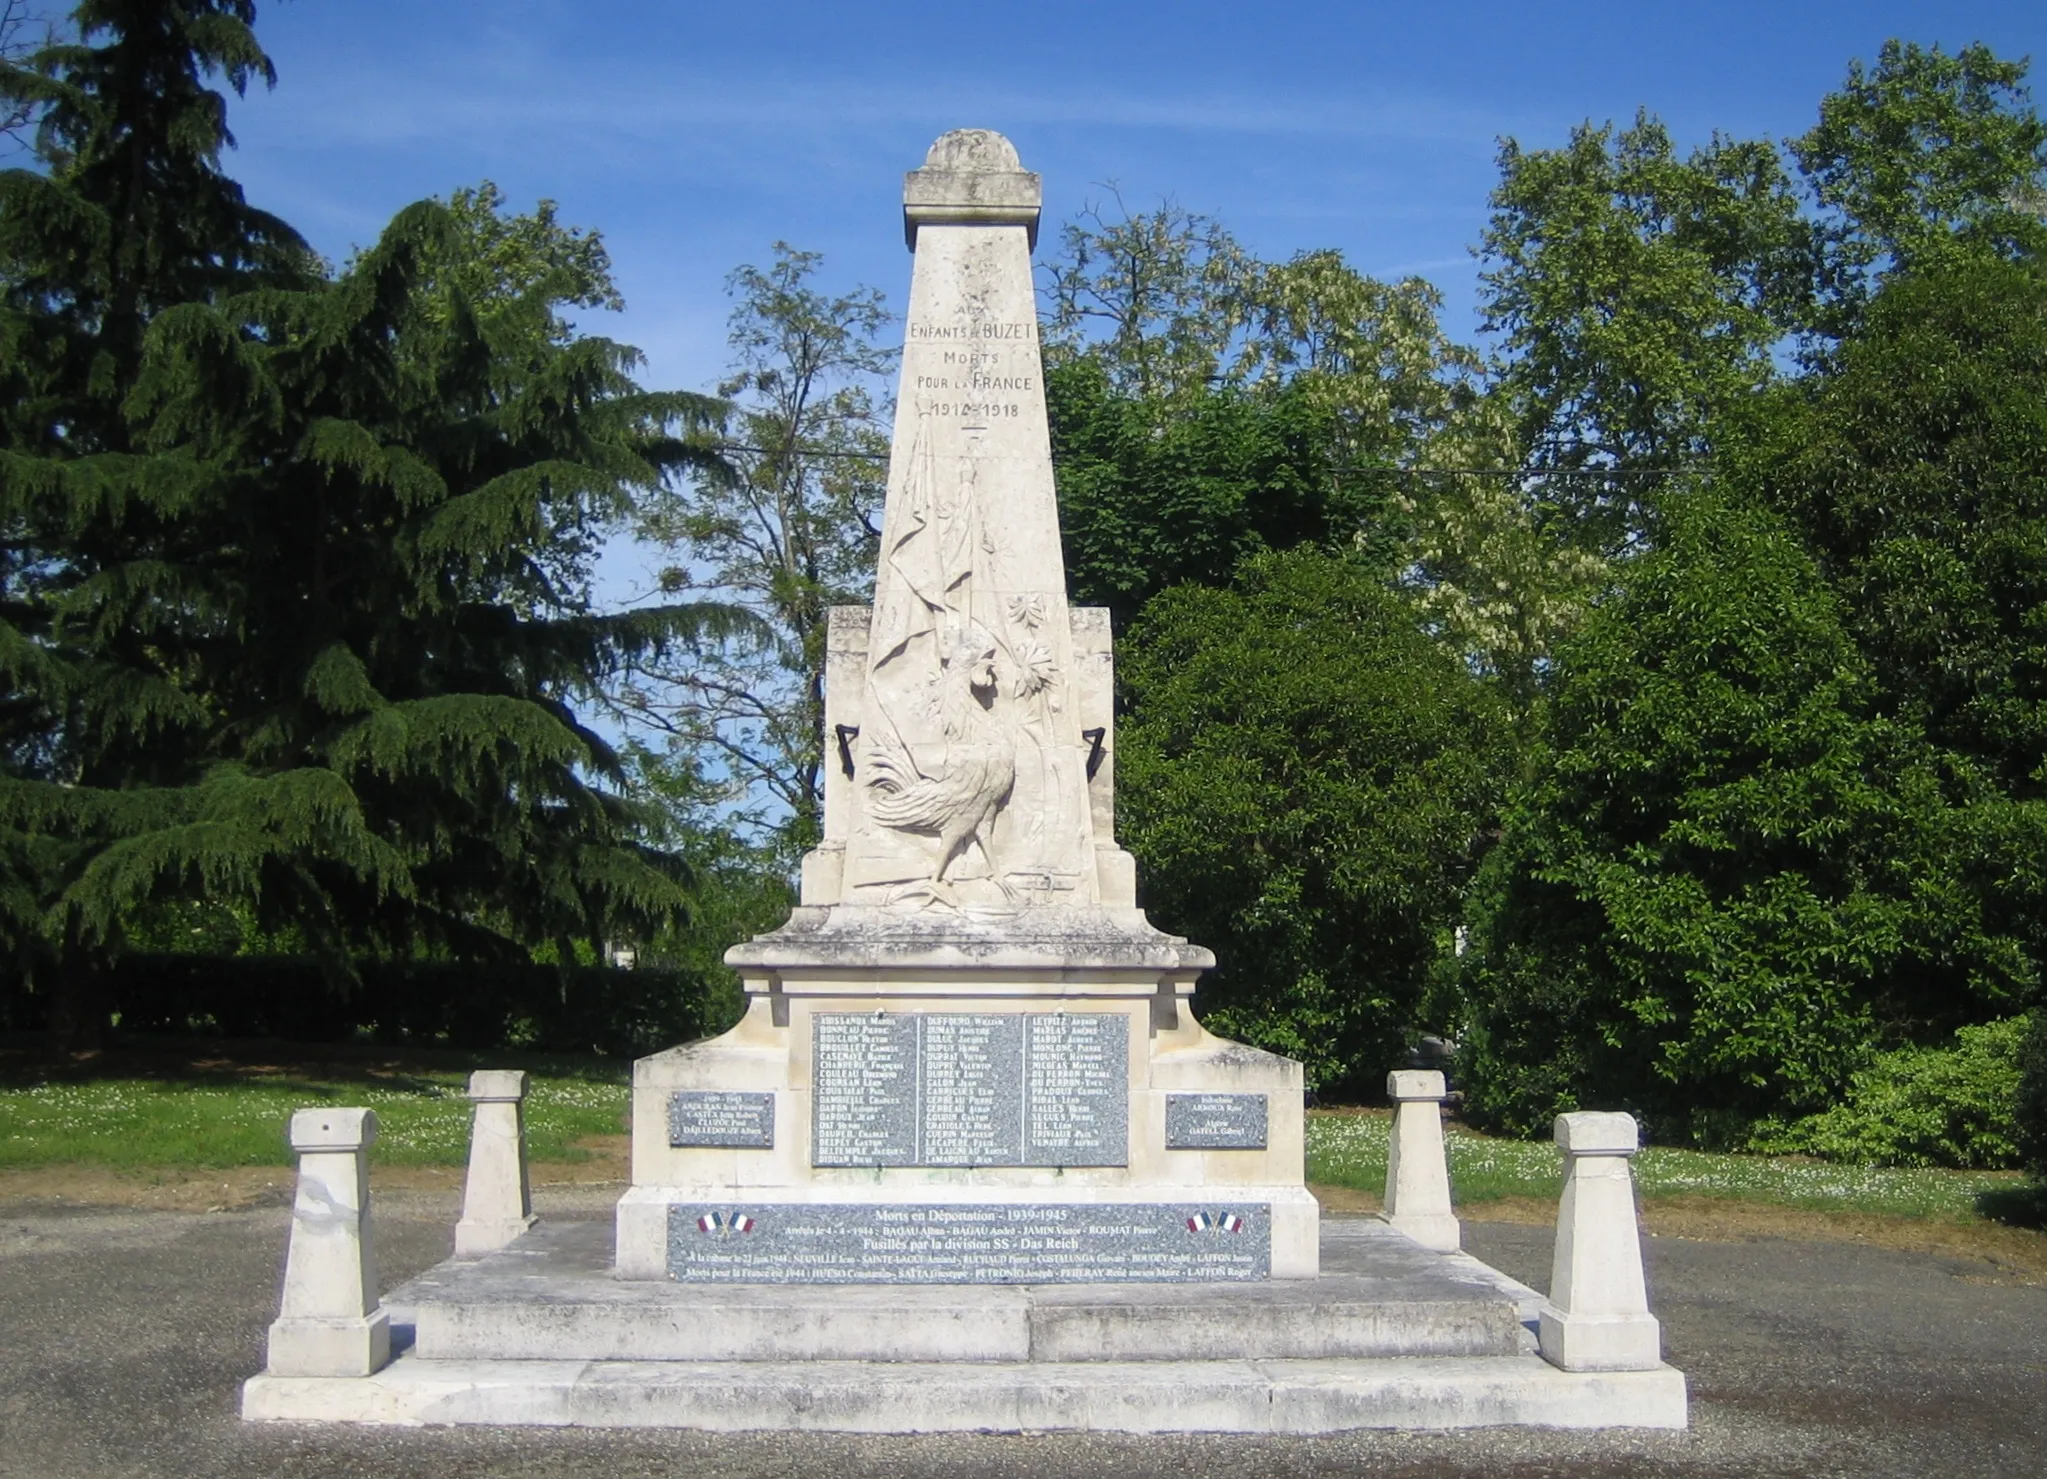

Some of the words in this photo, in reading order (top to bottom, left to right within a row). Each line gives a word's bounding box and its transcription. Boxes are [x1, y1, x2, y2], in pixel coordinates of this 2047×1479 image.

[910, 322, 967, 338] ENFANTS
[983, 323, 1031, 339] BUZET
[943, 351, 1000, 364] MORTS
[917, 376, 948, 389] POUR
[954, 381, 969, 389] LA
[972, 371, 1033, 390] FRANCE
[876, 1210, 910, 1222] Morts
[911, 1212, 926, 1221] en
[929, 1209, 996, 1224] Déportation
[1008, 1208, 1068, 1222] 1939-1945
[863, 1238, 907, 1250] Fusillés
[909, 1241, 929, 1253] par
[931, 1238, 942, 1250] la
[944, 1237, 991, 1250] division
[993, 1238, 1010, 1250] SS
[1020, 1238, 1043, 1250] Das
[1046, 1237, 1080, 1250] Reich
